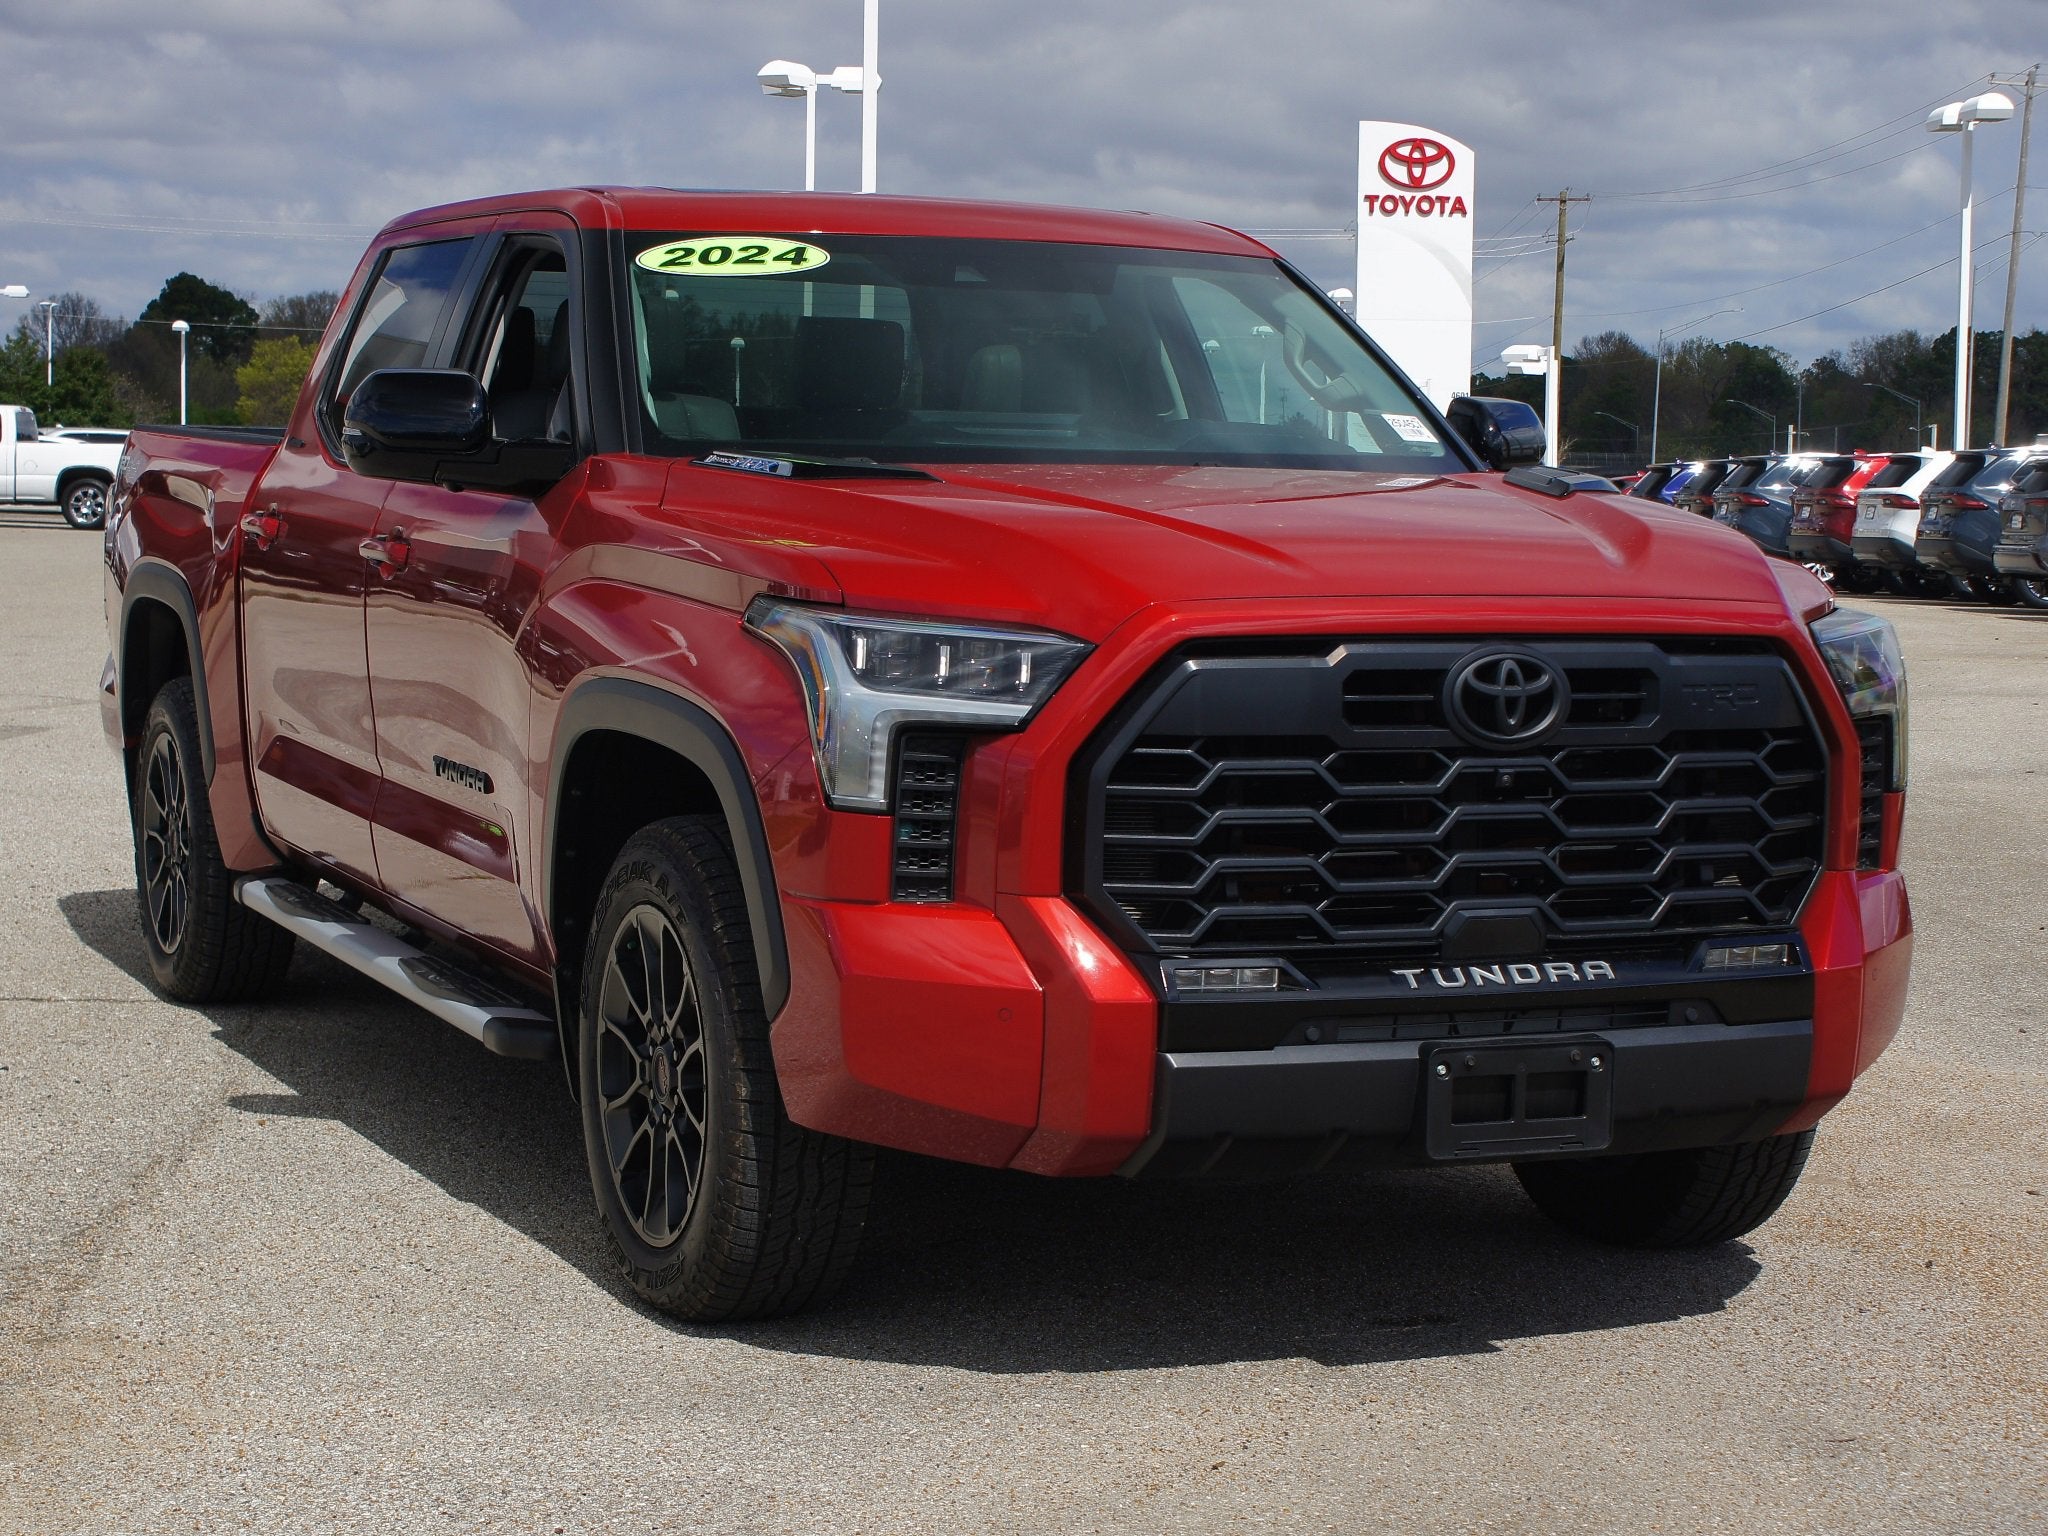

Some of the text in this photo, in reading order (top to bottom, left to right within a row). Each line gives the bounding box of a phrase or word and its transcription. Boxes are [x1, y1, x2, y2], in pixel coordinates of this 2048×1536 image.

[1364, 194, 1467, 217] TOYOTA
[659, 245, 809, 268] 2024
[1681, 682, 1760, 711] TRD
[432, 754, 495, 794] TUNDRA
[1391, 960, 1616, 990] TUNDRA
